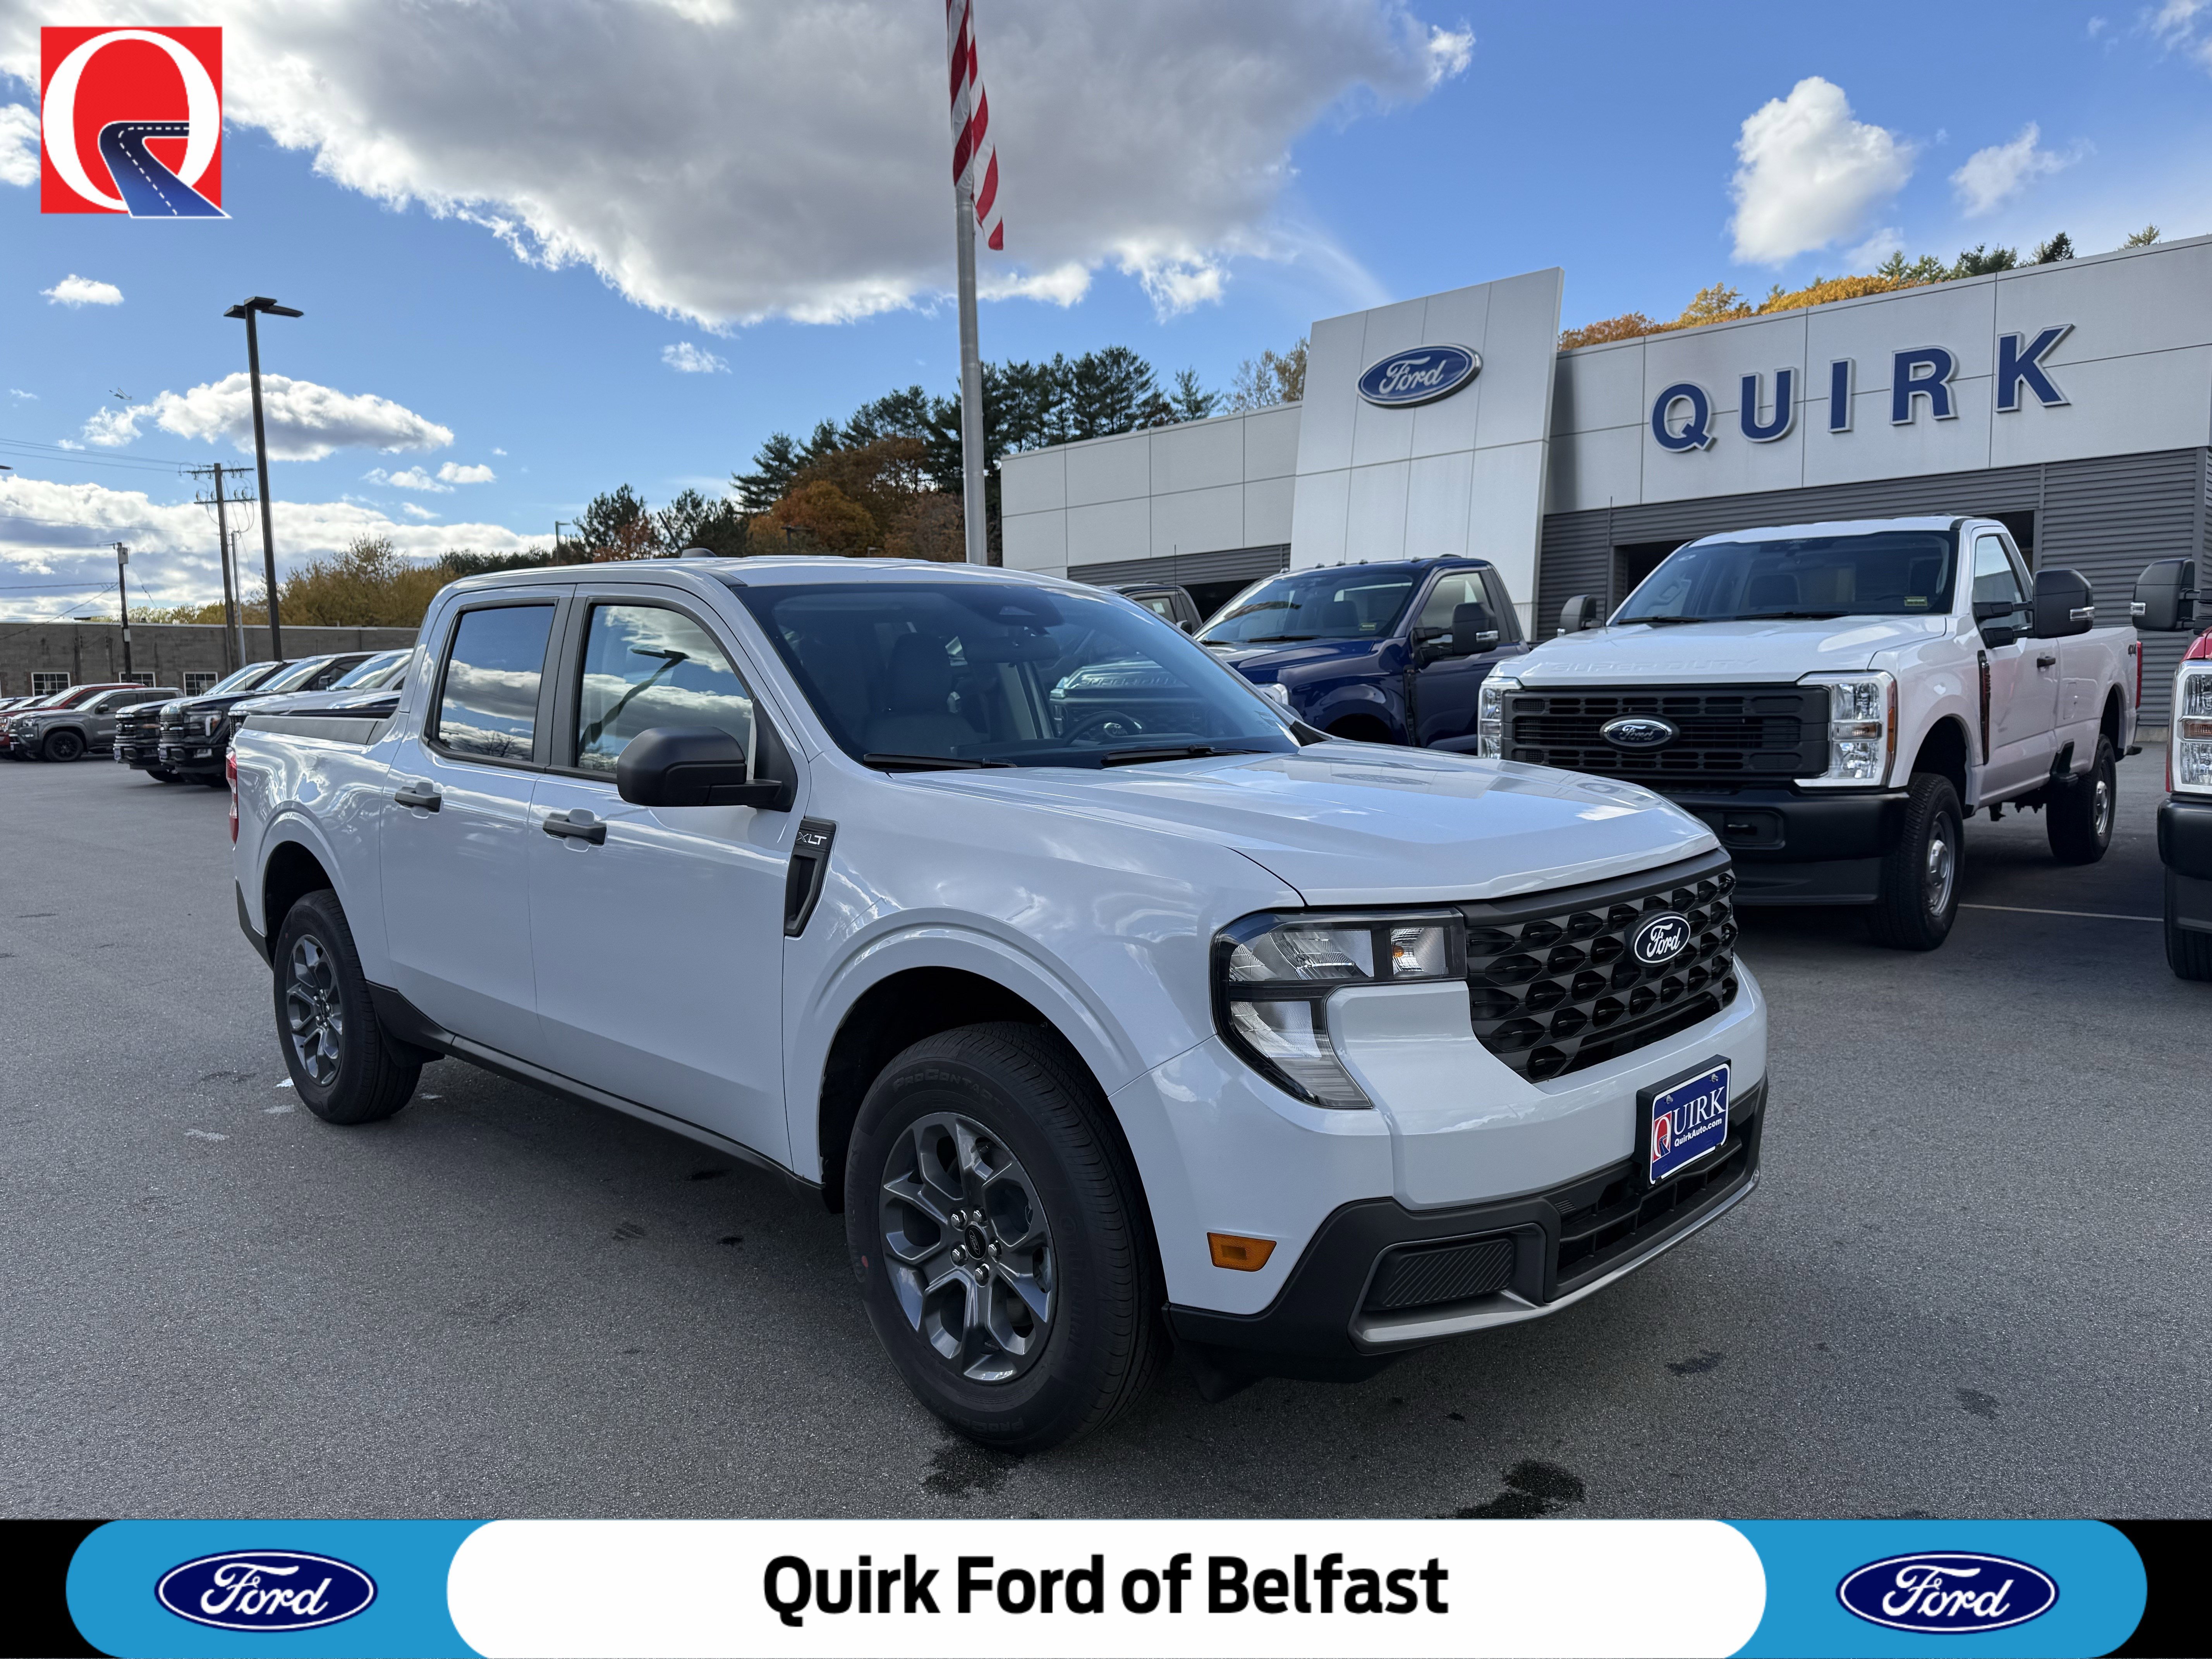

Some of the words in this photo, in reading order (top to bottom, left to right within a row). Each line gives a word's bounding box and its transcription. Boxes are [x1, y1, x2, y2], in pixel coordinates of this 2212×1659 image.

[1379, 356, 1447, 394] Ford
[1649, 323, 2075, 453] QUIRK
[1618, 725, 1656, 741] Ford
[795, 831, 827, 845] XLT
[1647, 923, 1681, 958] Ford
[1653, 1086, 1726, 1158] QUIRK
[1674, 1117, 1723, 1147] QuirkAuto.com
[970, 1234, 979, 1250] Ford
